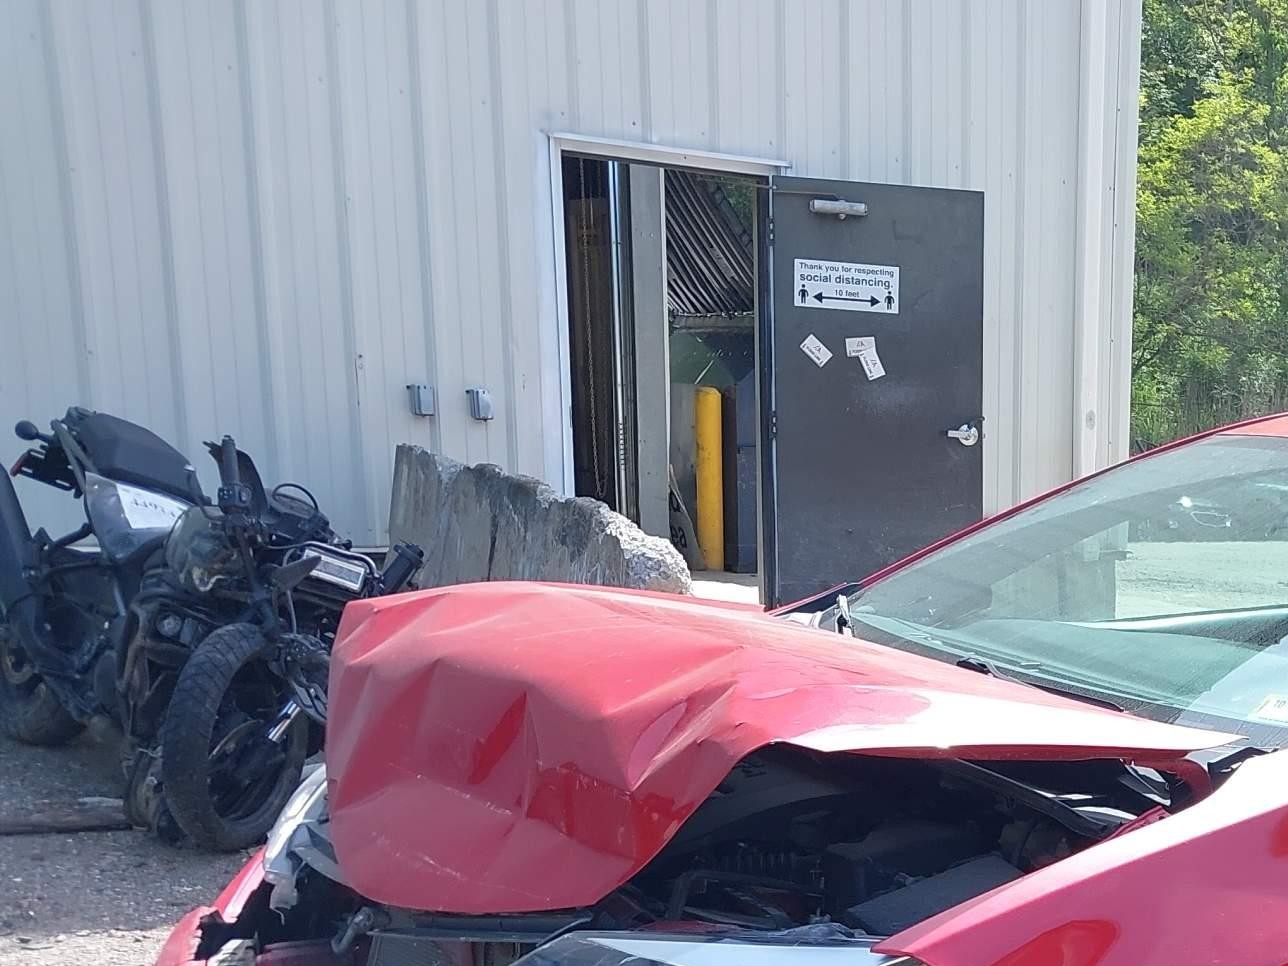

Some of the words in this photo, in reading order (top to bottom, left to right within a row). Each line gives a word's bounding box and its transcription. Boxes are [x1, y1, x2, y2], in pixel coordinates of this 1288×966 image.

[799, 262, 823, 270] Thank
[825, 264, 840, 273] you
[841, 265, 853, 273] for
[854, 268, 895, 278] respecting
[799, 273, 832, 283] social
[834, 274, 894, 290] distancing.
[835, 289, 844, 297] 10
[845, 290, 860, 298] feet
